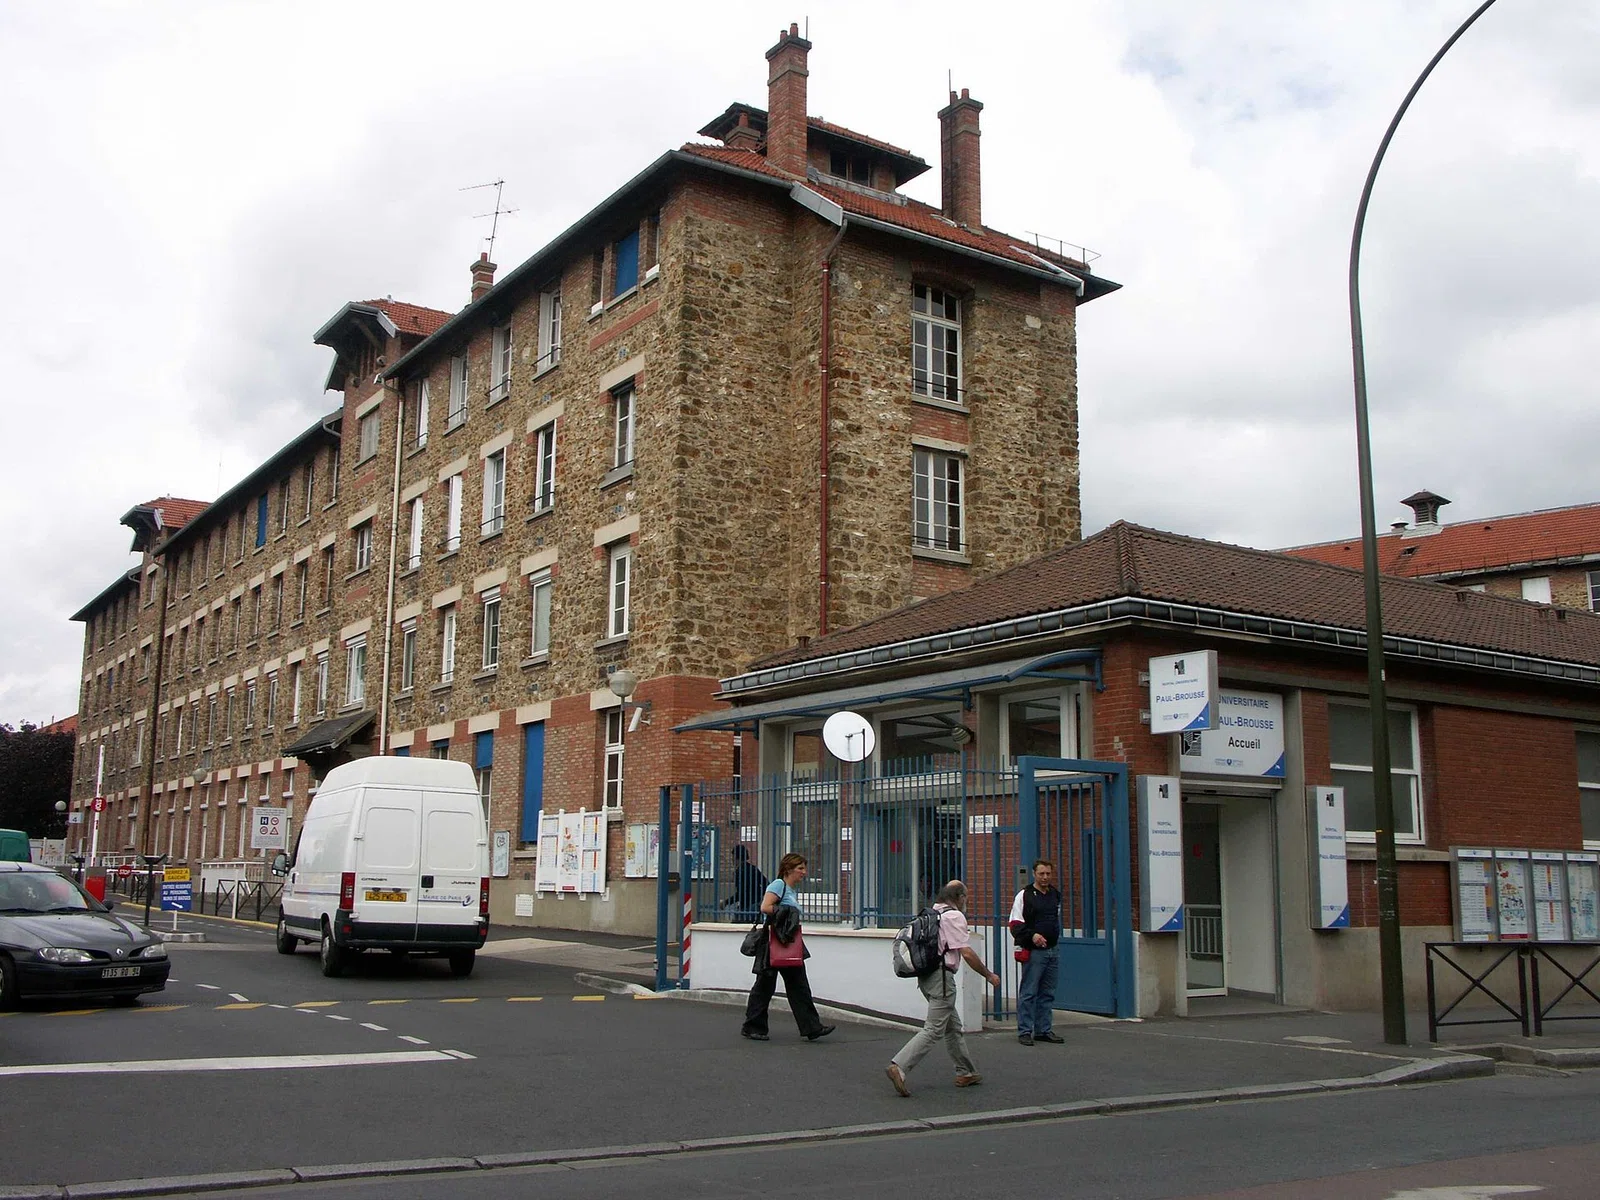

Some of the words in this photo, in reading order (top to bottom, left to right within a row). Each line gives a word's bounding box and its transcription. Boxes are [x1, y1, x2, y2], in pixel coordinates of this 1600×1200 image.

[1156, 691, 1205, 703] PAUL-BROUSSE
[1219, 716, 1274, 730] AUL-BROUSSE
[1228, 736, 1261, 750] Accueil
